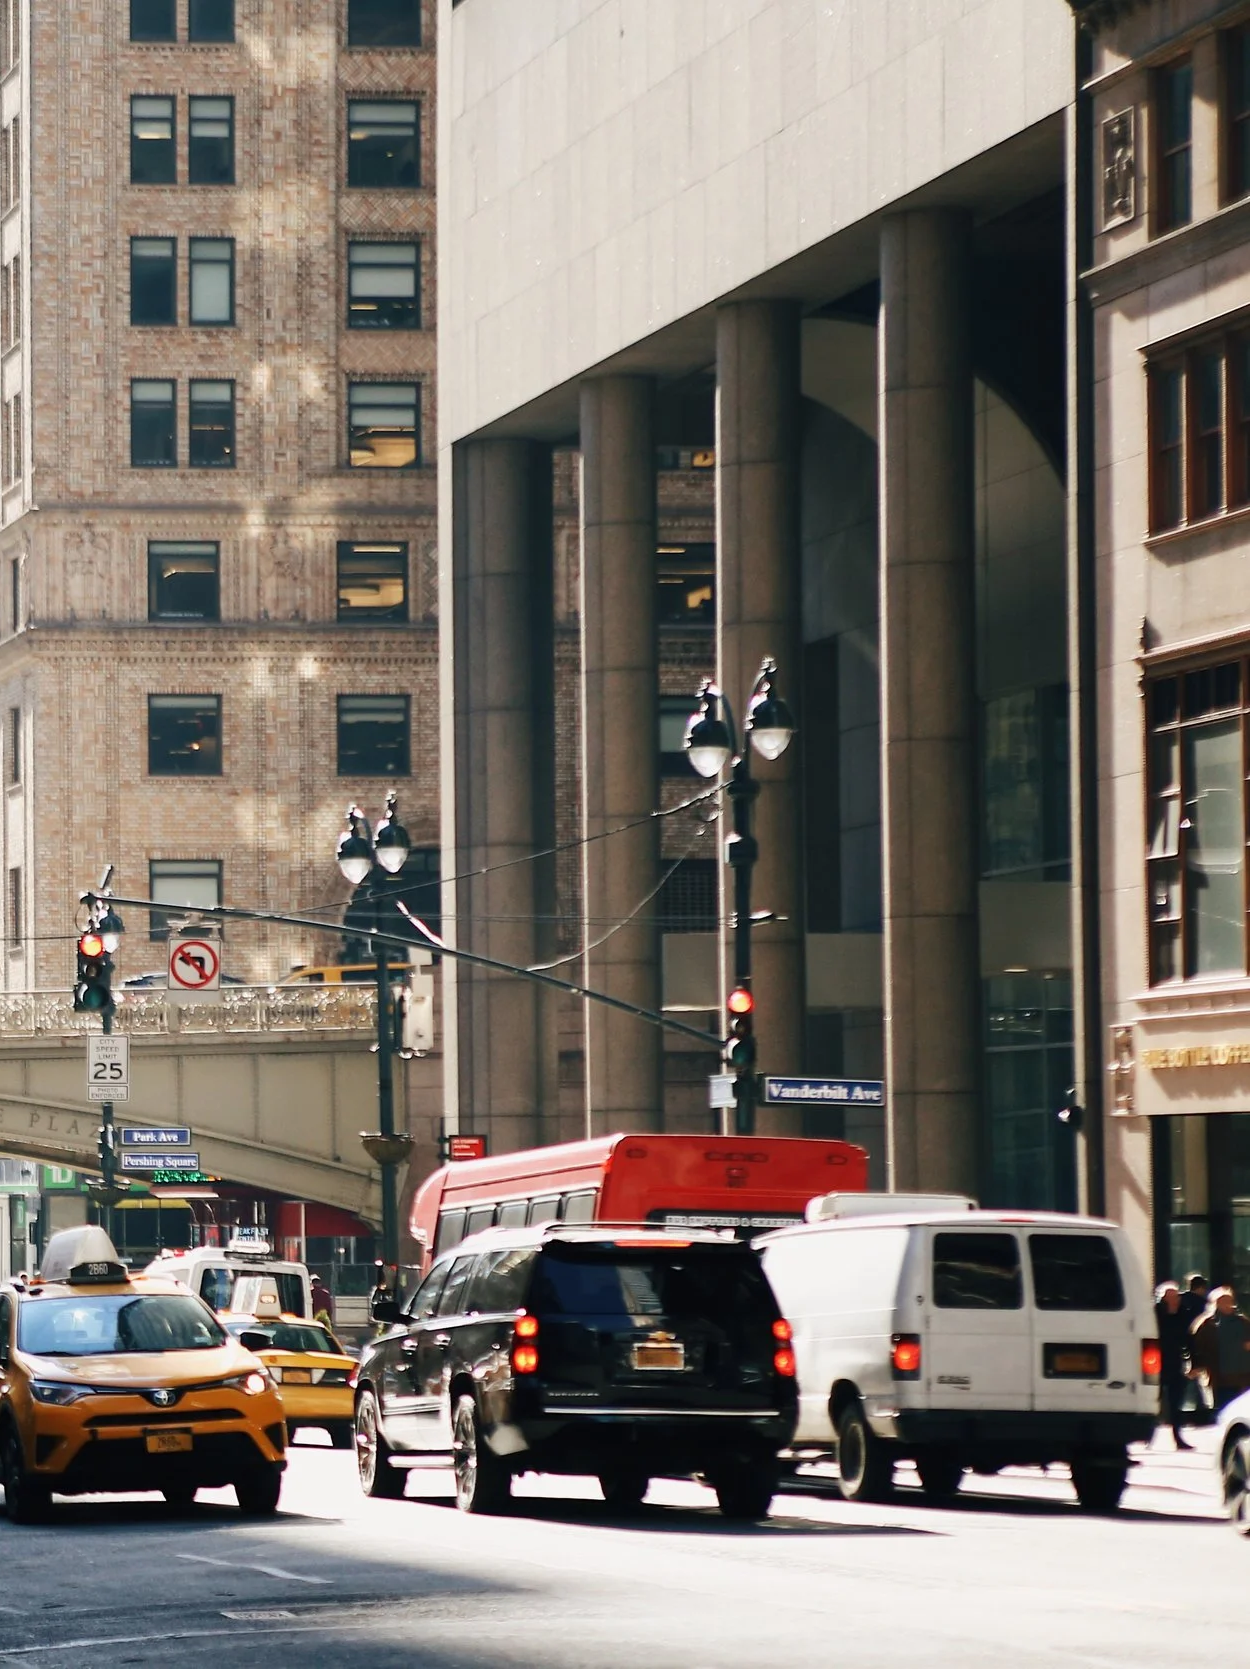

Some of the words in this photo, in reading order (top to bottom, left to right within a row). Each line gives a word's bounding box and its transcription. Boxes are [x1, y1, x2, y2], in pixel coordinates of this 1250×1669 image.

[93, 1062, 123, 1080] 25
[769, 1083, 849, 1099] Vanderbilt
[850, 1086, 881, 1100] Ave
[28, 1115, 103, 1138] PLAZ
[133, 1132, 157, 1142] Park
[158, 1132, 178, 1142] Ave
[124, 1157, 164, 1168] Pershing
[165, 1157, 197, 1168] Square
[88, 1263, 108, 1276] 2B60
